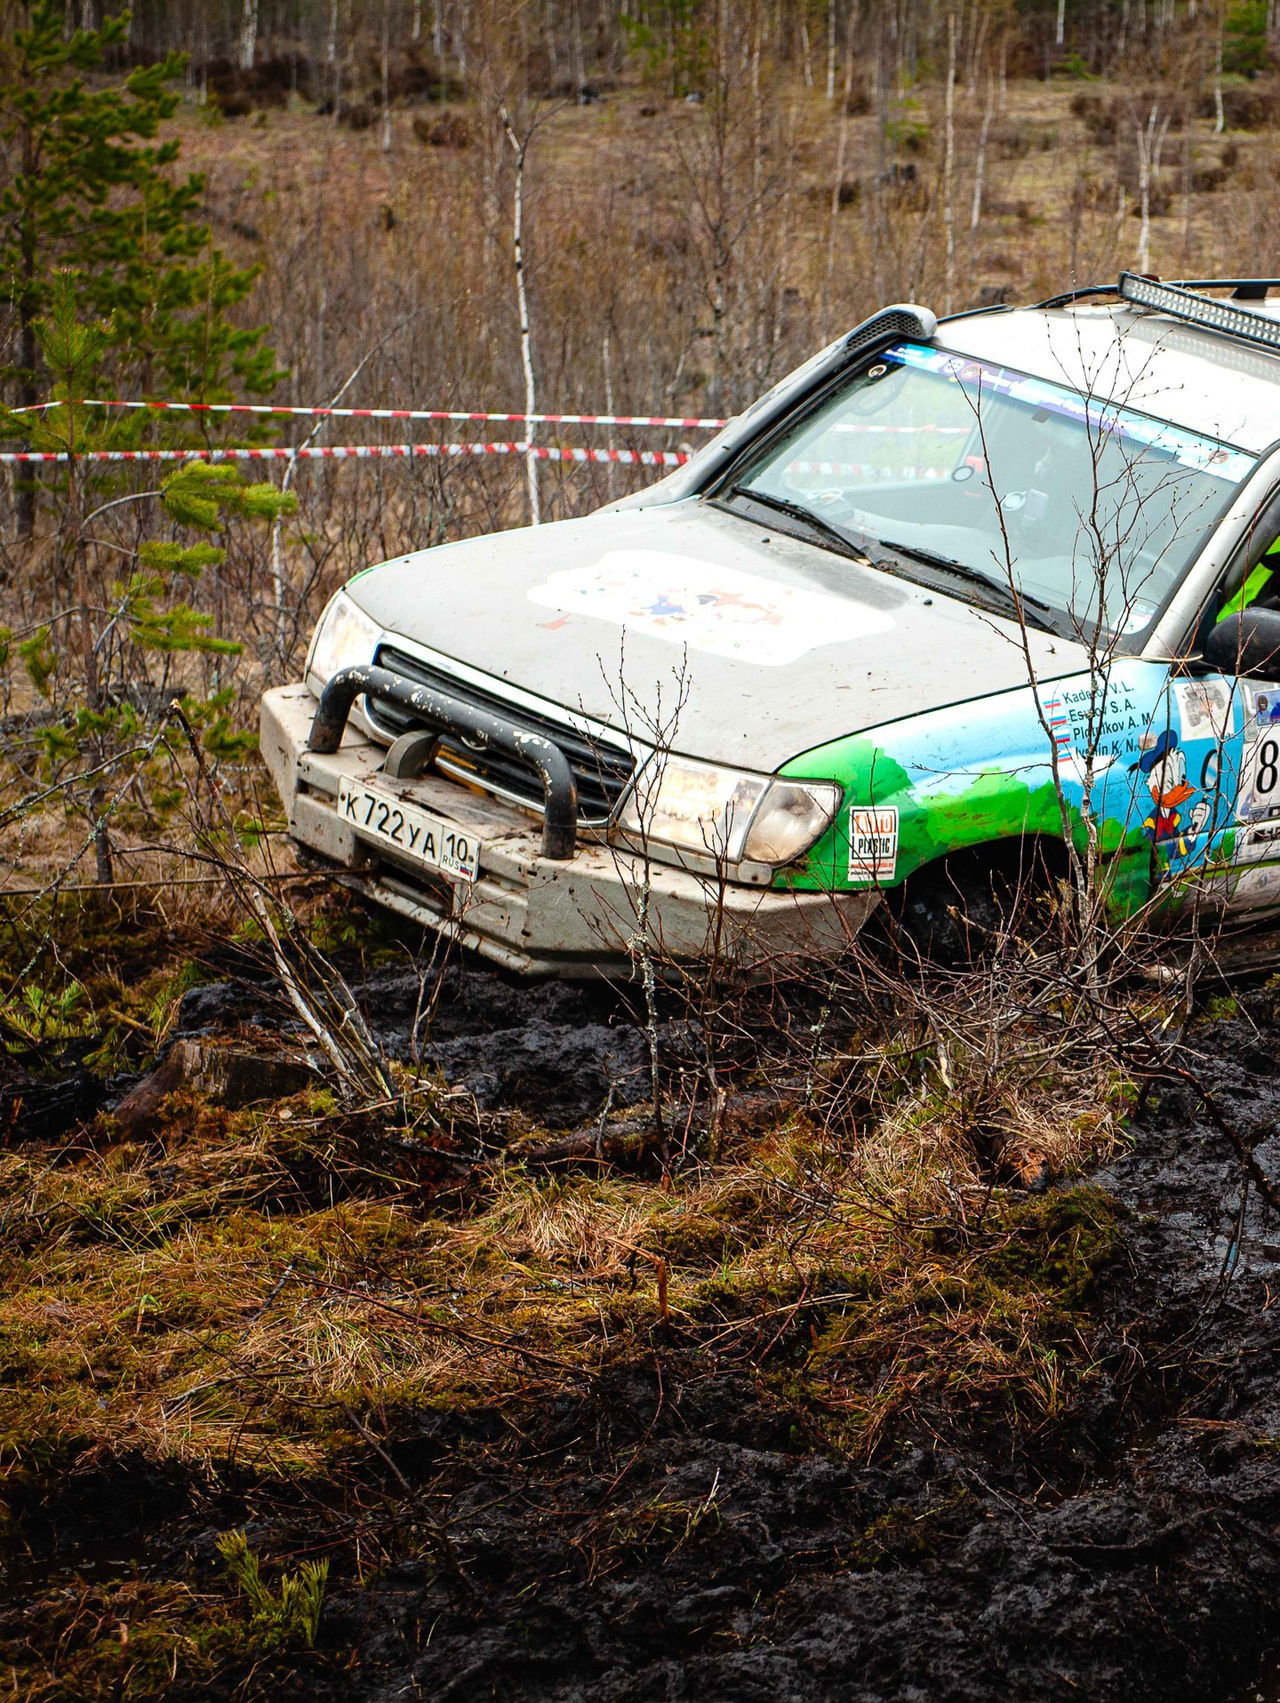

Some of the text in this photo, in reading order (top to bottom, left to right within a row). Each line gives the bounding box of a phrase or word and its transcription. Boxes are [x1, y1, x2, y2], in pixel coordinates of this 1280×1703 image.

[1109, 682, 1122, 694] V.
[1121, 681, 1135, 693] L.
[1069, 698, 1136, 722] Esov S. A.
[1128, 716, 1140, 729] A.
[1141, 712, 1155, 725] M.
[1075, 743, 1108, 760] Ivin
[1126, 738, 1138, 753] N.
[446, 833, 468, 862] 10
[442, 854, 460, 870] RUS
